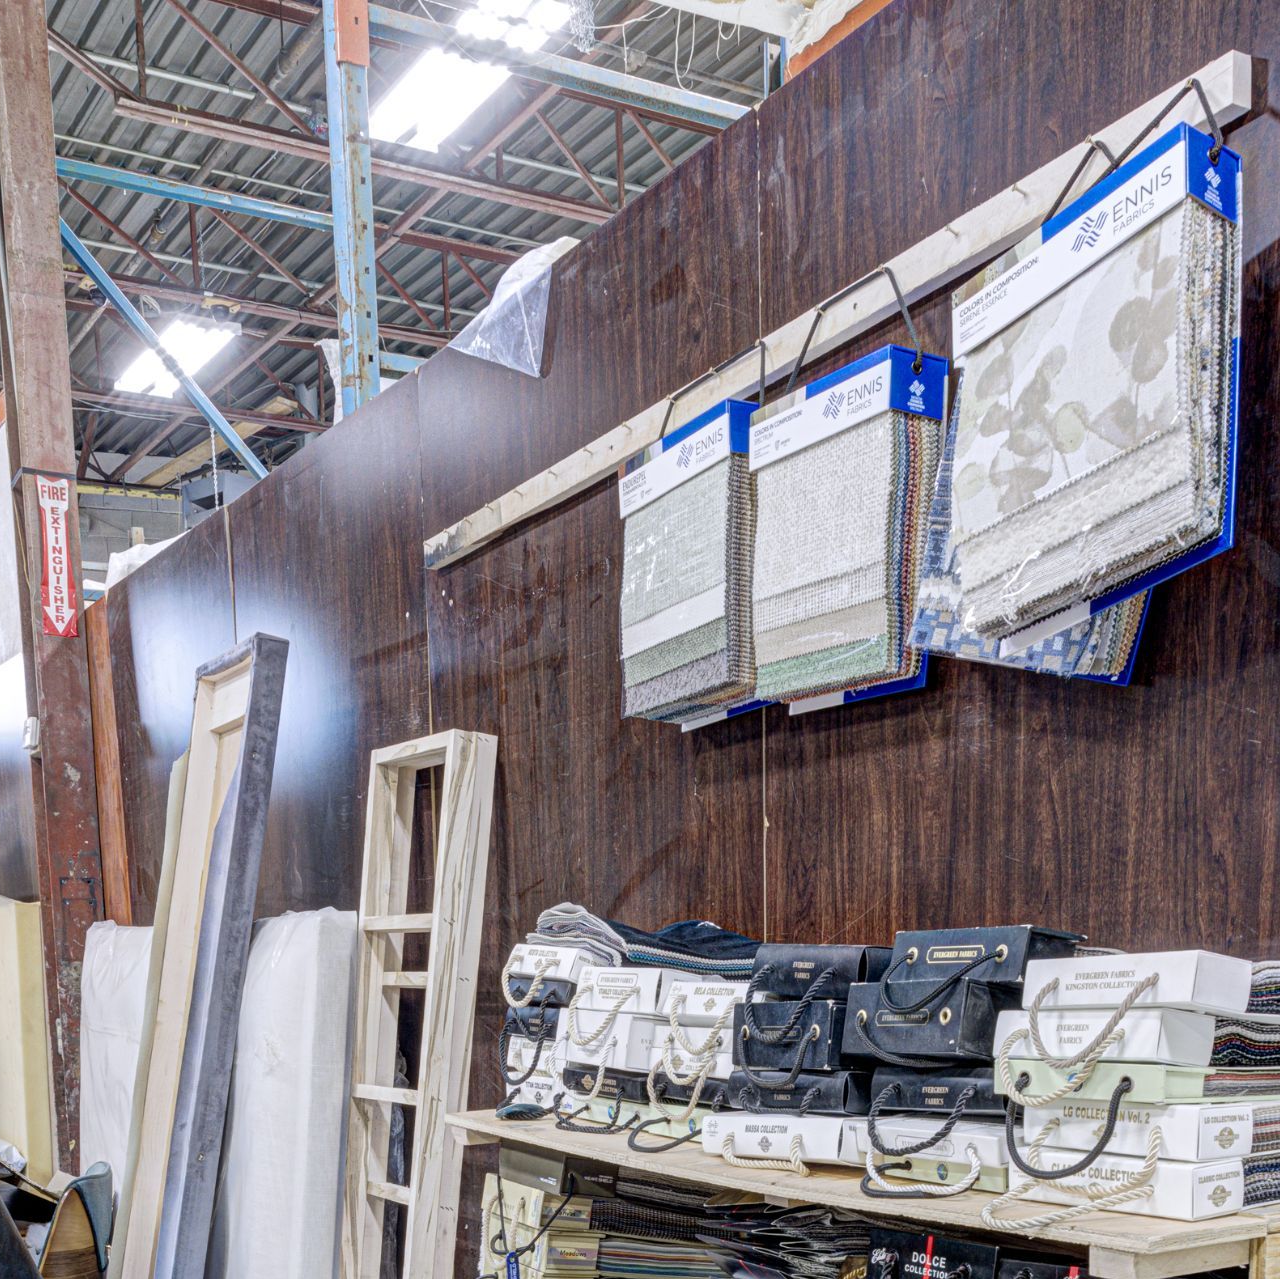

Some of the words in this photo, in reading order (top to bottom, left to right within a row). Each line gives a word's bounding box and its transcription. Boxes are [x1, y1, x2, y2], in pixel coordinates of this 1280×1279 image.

[1113, 166, 1172, 223] ENNIS
[1113, 199, 1155, 236] FABRICS
[959, 297, 984, 318] COLORS
[985, 290, 992, 300] IN
[959, 308, 981, 328] SERENE
[982, 288, 1008, 312] ESSENCE
[847, 376, 883, 406] ENNIS
[847, 400, 872, 417] FABRICS
[695, 428, 724, 456] ENNIS
[695, 450, 716, 465] FABRICS
[40, 484, 67, 502] FIRE
[50, 506, 66, 624] EXTINGUISHER
[933, 951, 958, 959] EVERGREEN
[959, 950, 978, 958] FABRICS
[1074, 971, 1109, 981] EVERGREEN
[1110, 970, 1136, 979] FABRICS
[1065, 981, 1099, 991] KINGSTON
[1056, 1024, 1090, 1032] EVERGREEN
[1059, 1036, 1083, 1044] FABRICS
[922, 1086, 949, 1094] EVERGREEN
[925, 1097, 944, 1106] FABRICS
[1063, 1106, 1074, 1116] LG
[1075, 1106, 1126, 1121] COLLECTN
[1127, 1112, 1144, 1123] Vol.
[1144, 1113, 1150, 1124] 2
[1212, 1115, 1237, 1124] COLLECTION
[1051, 1162, 1086, 1178] CLAIC
[1088, 1167, 1136, 1182] COLLECTIO
[912, 1252, 947, 1268] DOLCE
